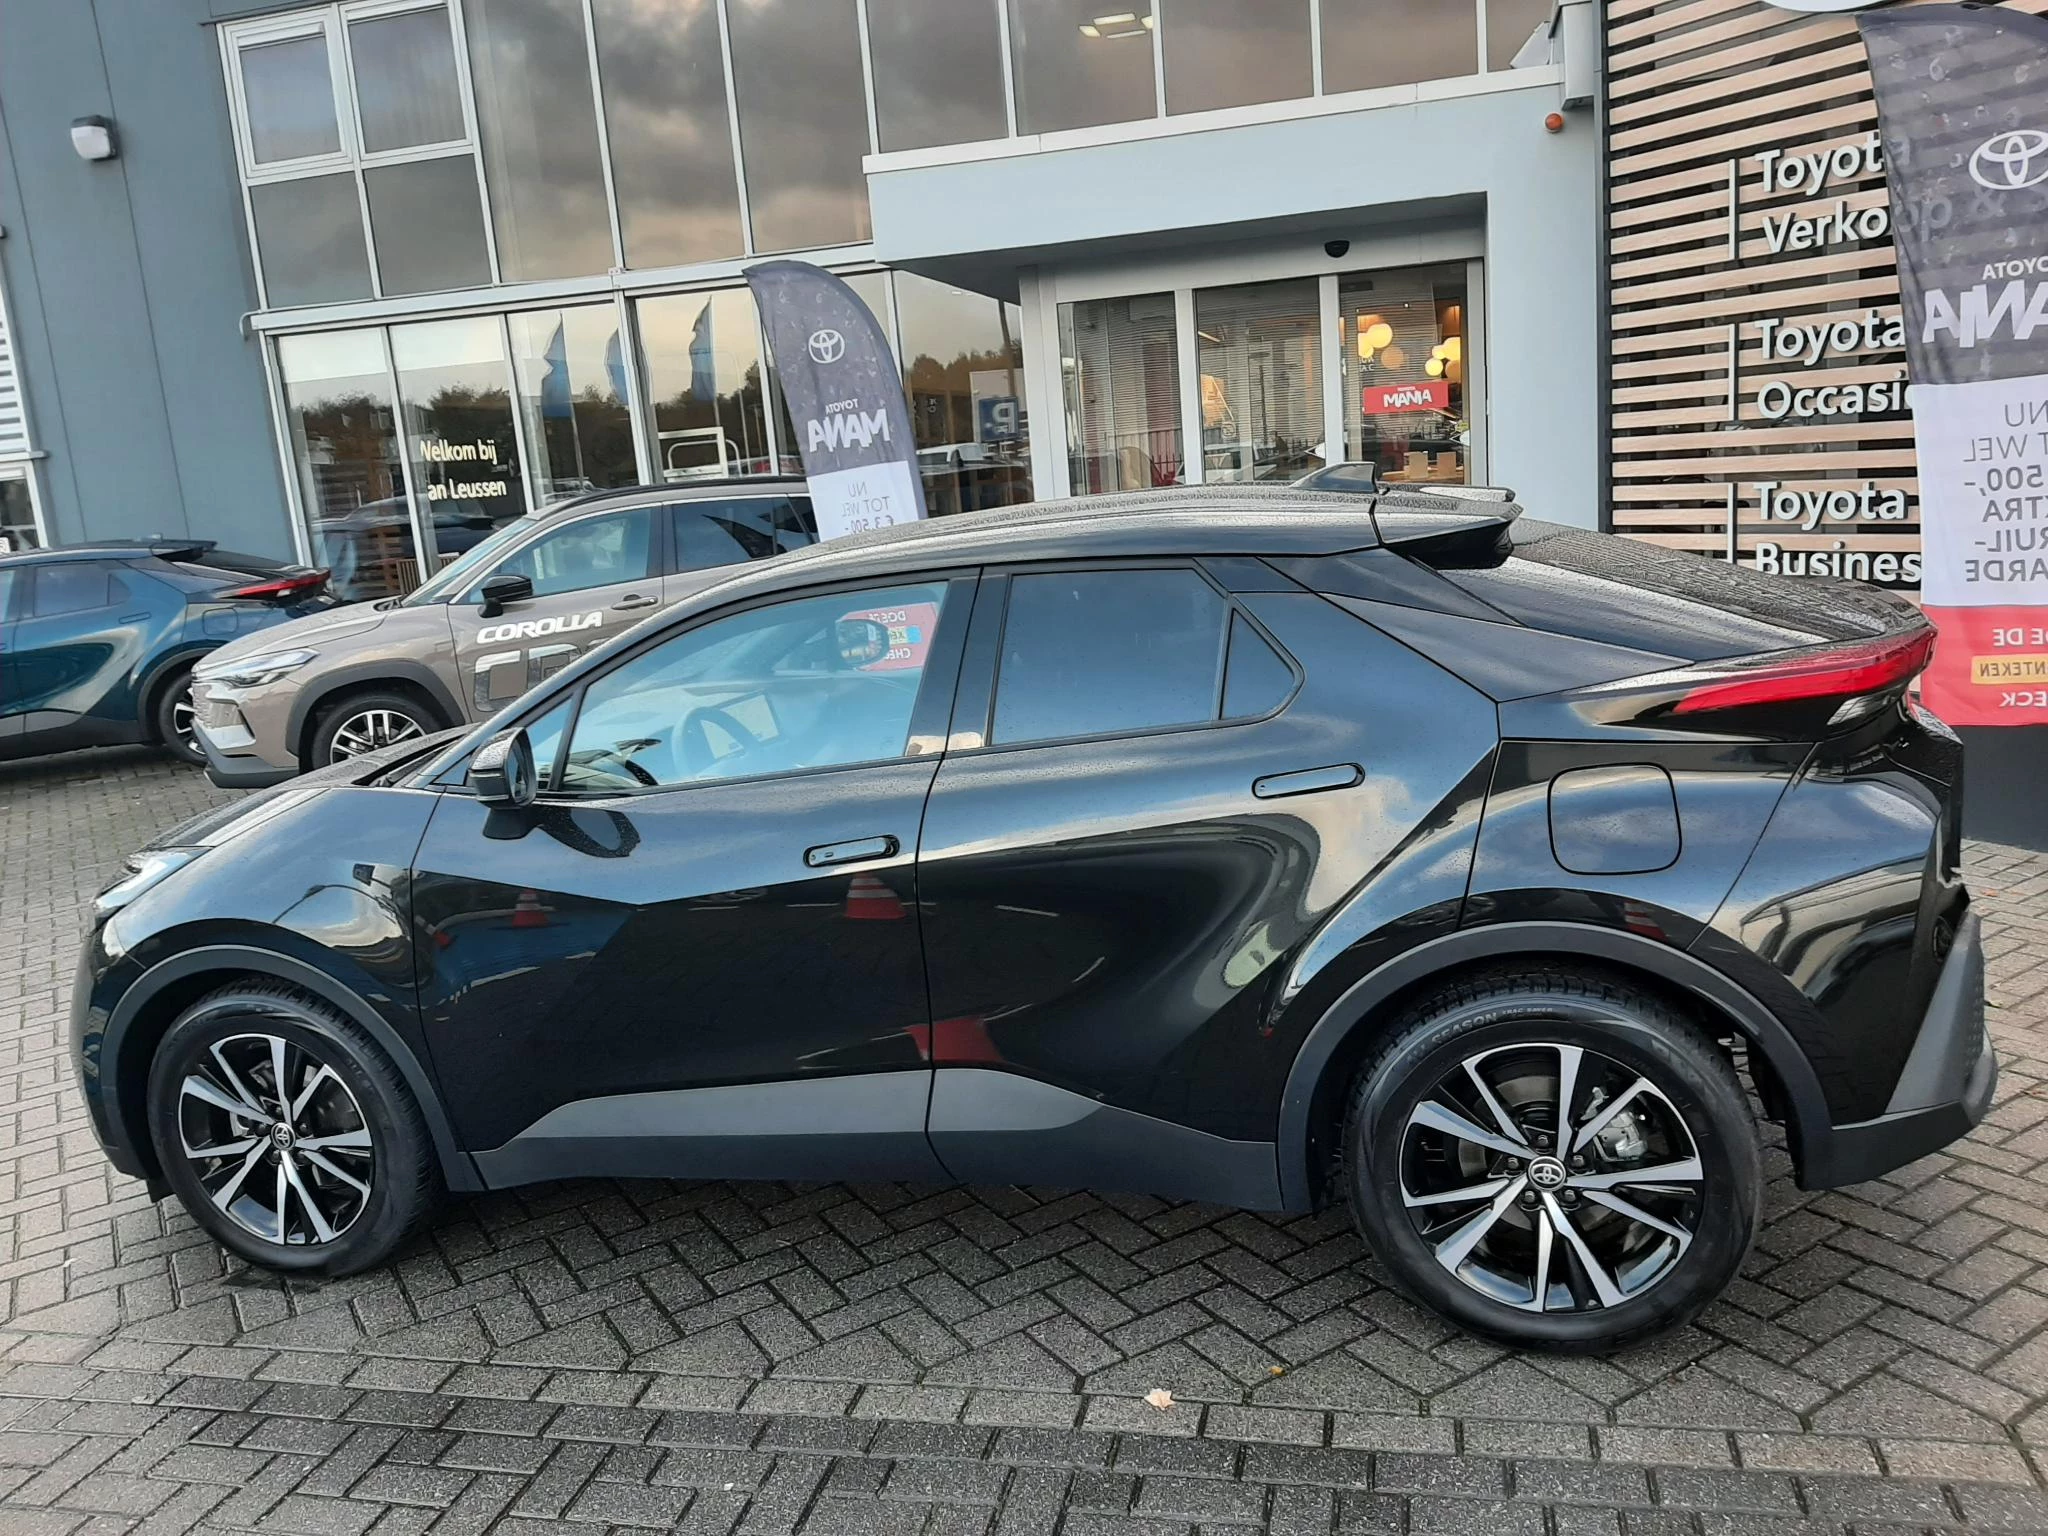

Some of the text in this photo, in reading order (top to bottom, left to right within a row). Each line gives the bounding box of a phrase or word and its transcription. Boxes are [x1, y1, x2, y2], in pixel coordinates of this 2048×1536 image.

[1755, 309, 1906, 367] Toyota
[1383, 388, 1433, 408] MANIA
[478, 438, 498, 465] bij
[427, 478, 507, 501] an Leussen
[1753, 480, 1907, 531] Toyota
[1756, 541, 1922, 583] Busines
[476, 610, 604, 644] COROLLA
